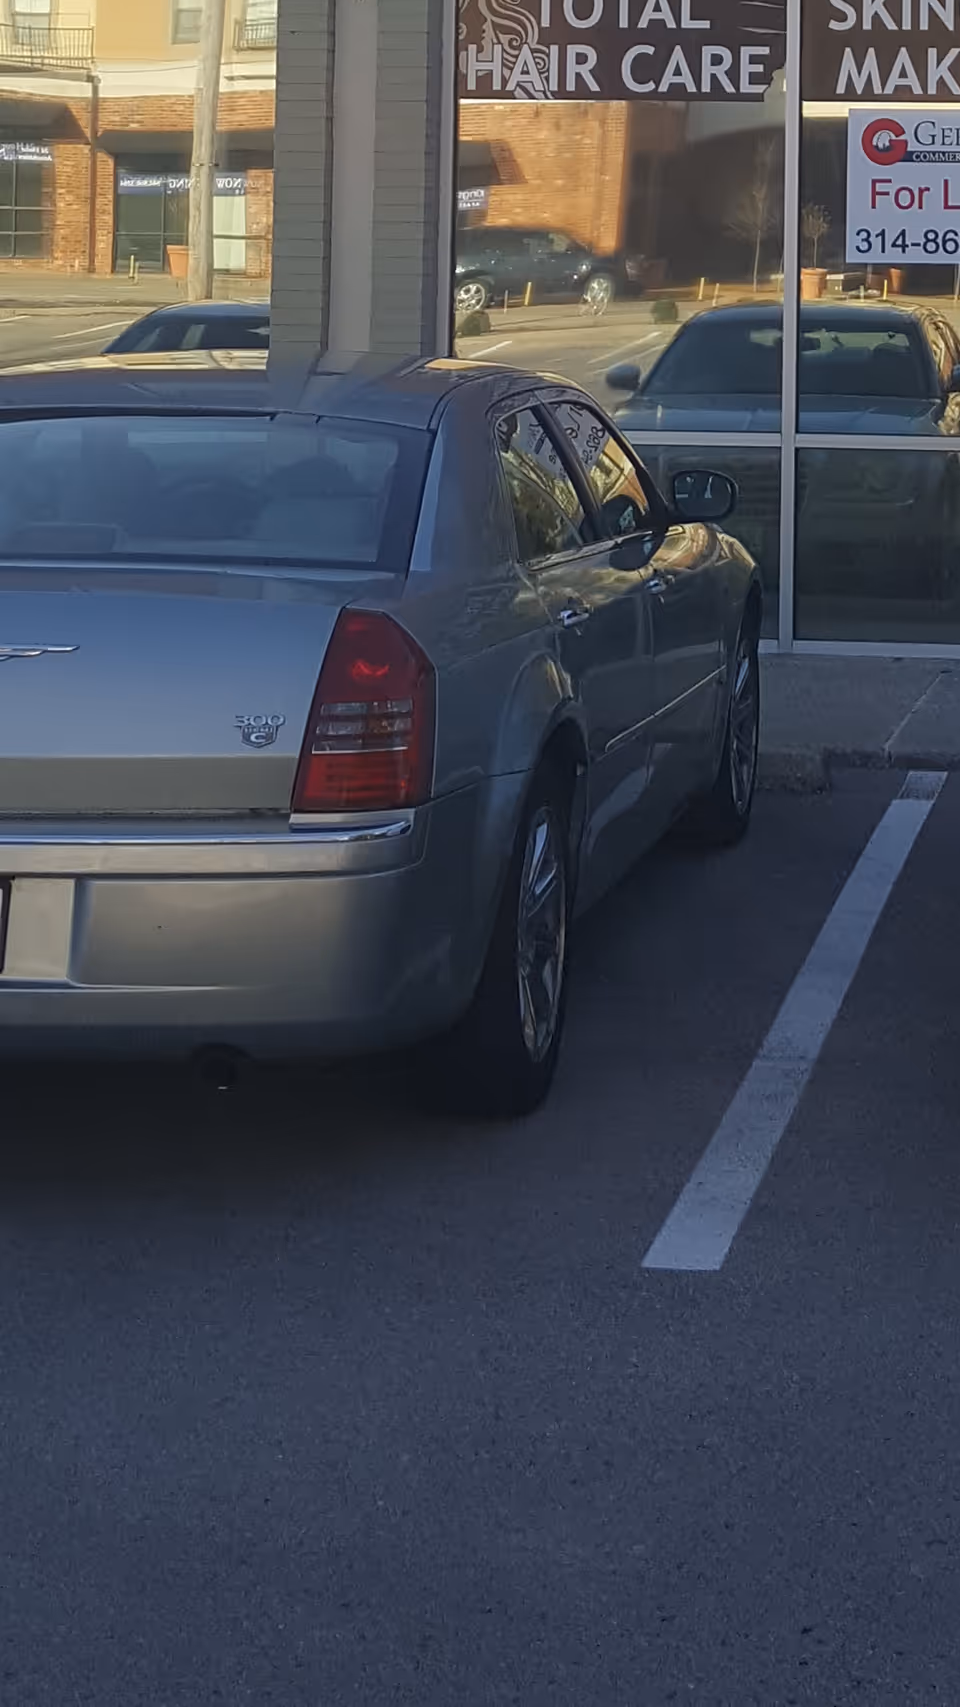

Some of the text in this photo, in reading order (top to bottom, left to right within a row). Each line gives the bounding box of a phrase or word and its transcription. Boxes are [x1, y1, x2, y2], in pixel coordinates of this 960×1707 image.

[466, 44, 771, 93] HAIR CARE
[870, 178, 931, 211] For
[233, 714, 287, 728] 300
